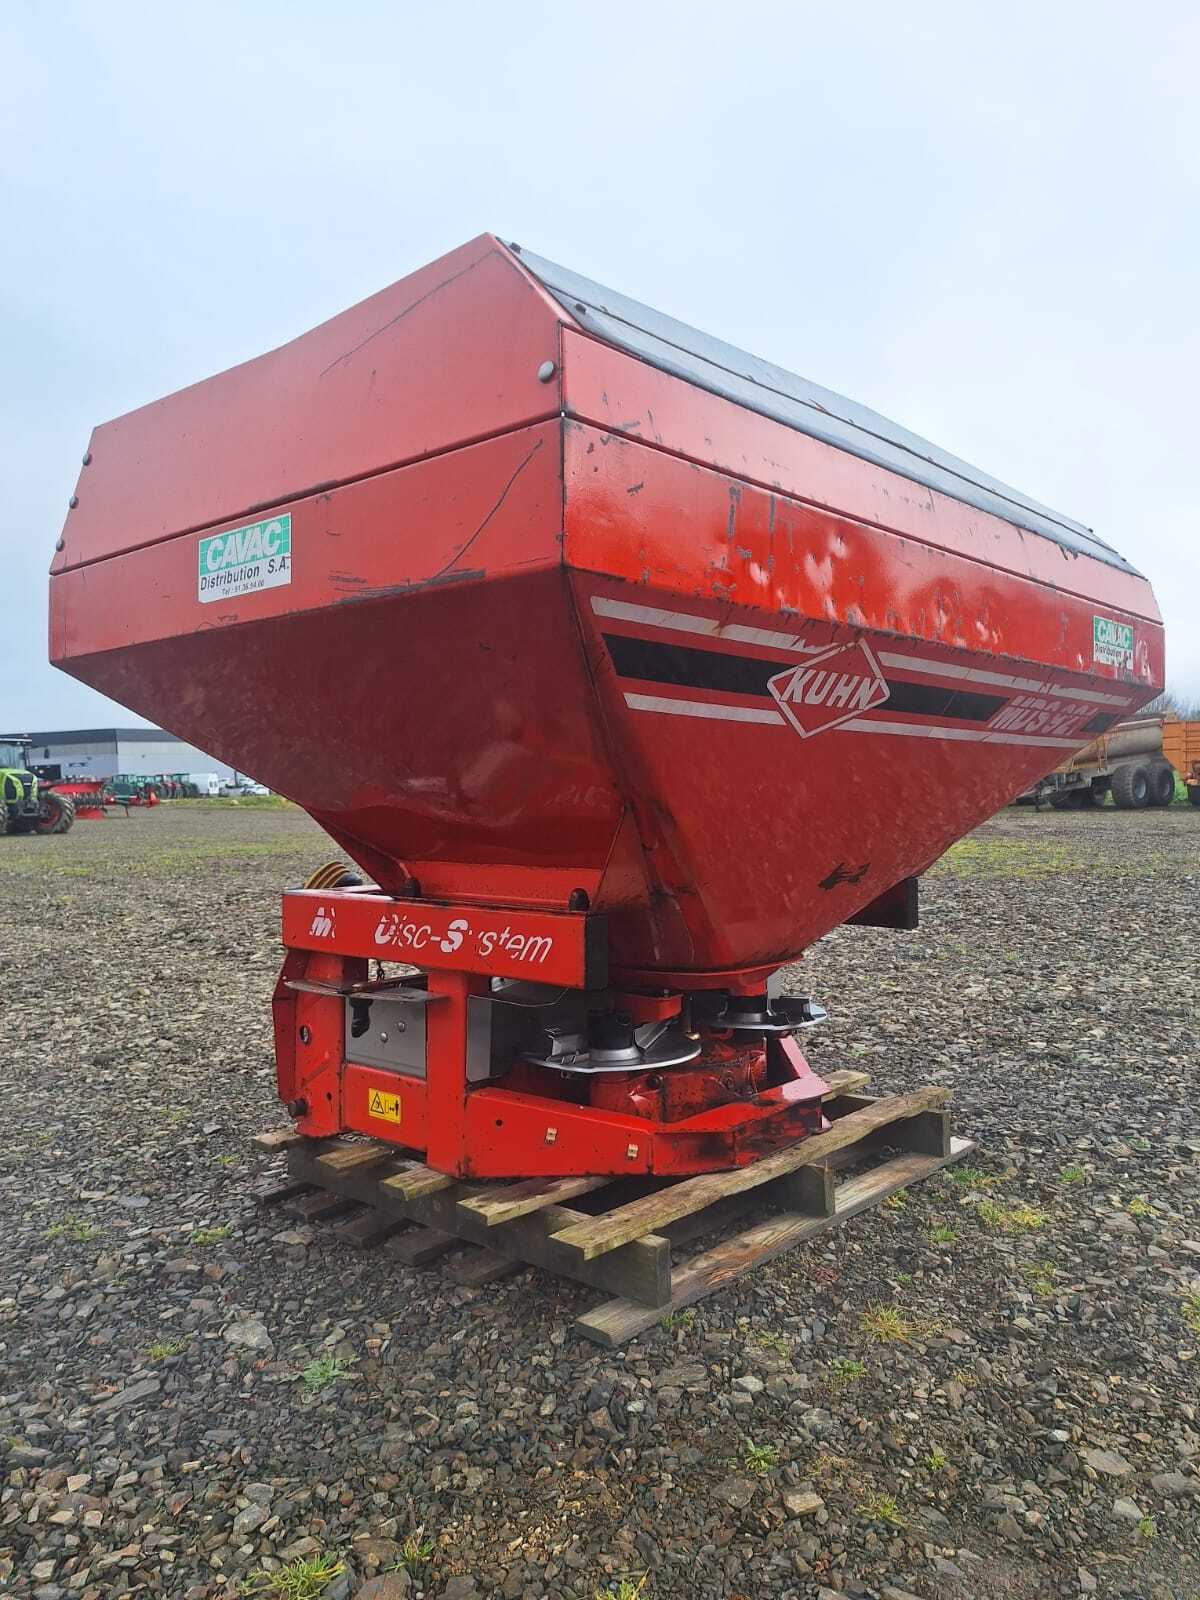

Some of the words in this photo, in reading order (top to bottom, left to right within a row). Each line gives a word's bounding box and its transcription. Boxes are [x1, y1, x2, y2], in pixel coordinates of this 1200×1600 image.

[206, 519, 281, 571] CAVAC
[200, 566, 260, 591] Distribution
[268, 556, 290, 574] S.A.
[780, 667, 881, 710] KUHN
